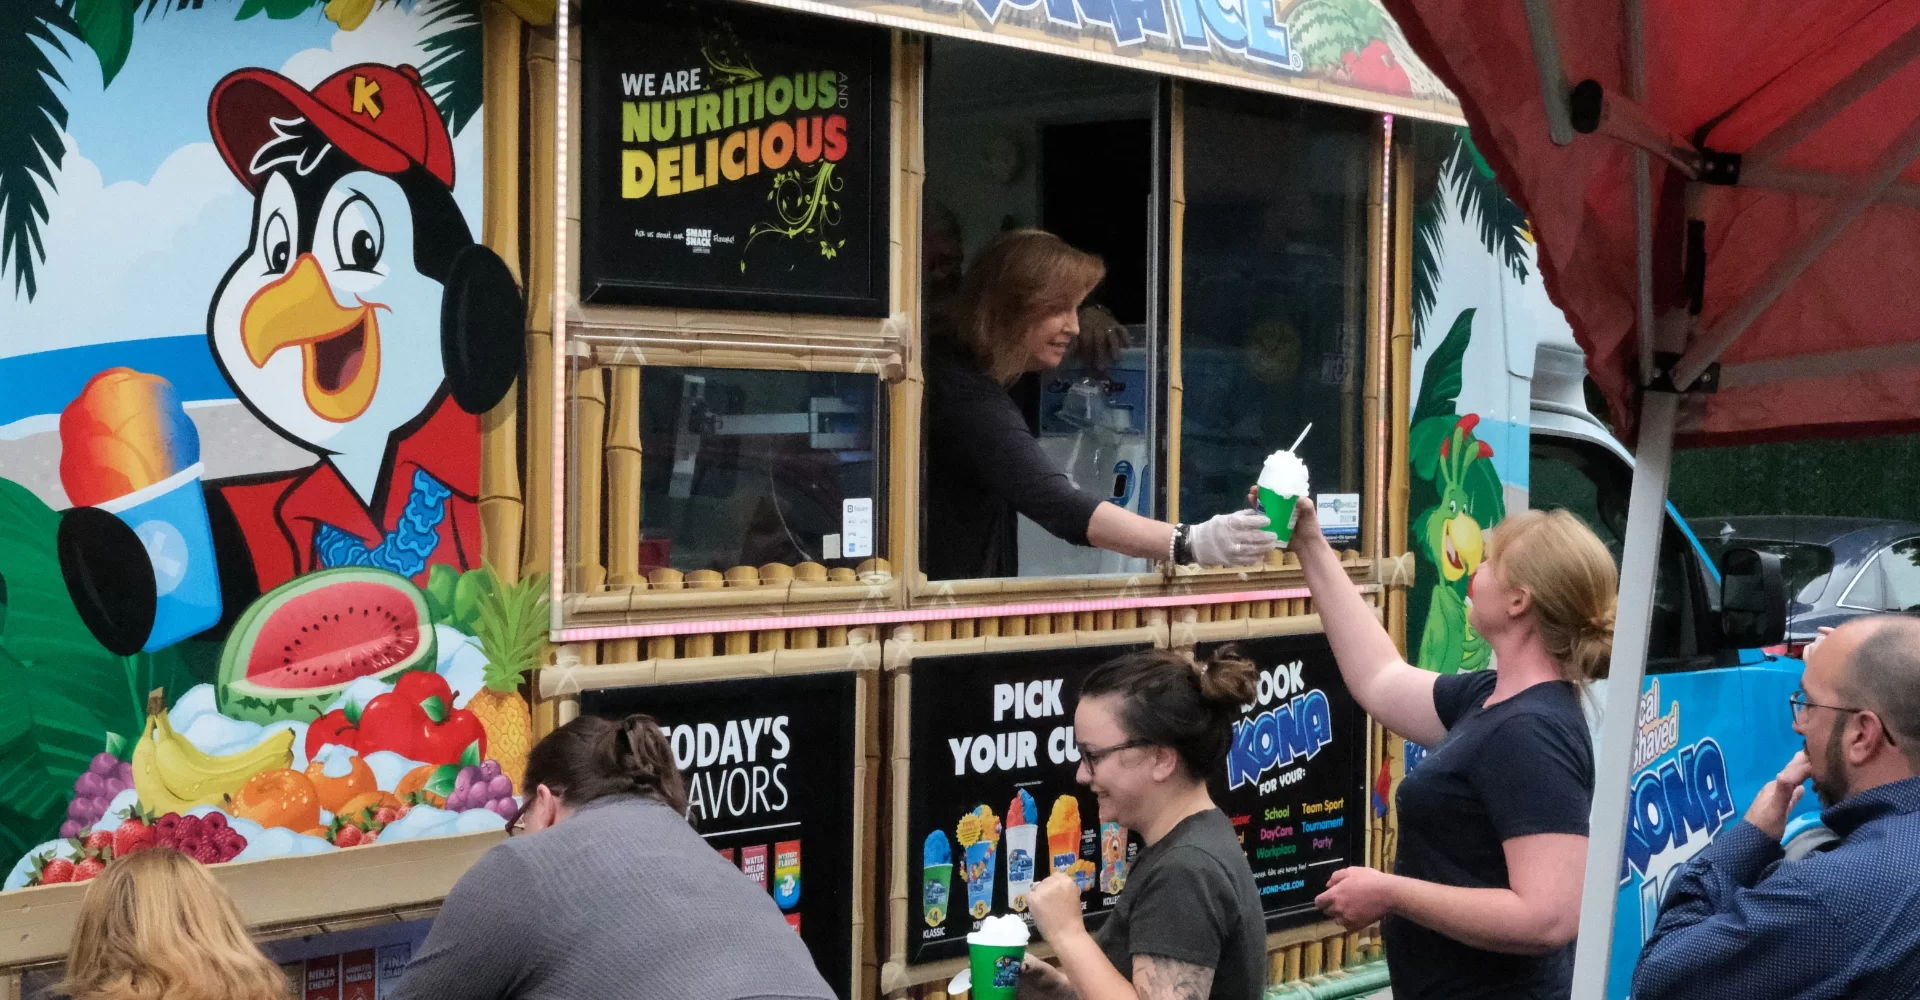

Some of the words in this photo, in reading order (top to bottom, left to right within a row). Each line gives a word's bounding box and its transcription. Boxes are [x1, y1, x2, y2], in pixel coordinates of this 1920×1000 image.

[621, 73, 656, 97] WE
[661, 68, 702, 95] ARE
[838, 71, 849, 109] AND
[352, 76, 381, 119] K
[621, 70, 838, 143] NUTRITIOUS
[621, 114, 848, 199] DELICIOUS
[686, 228, 712, 238] SMART
[686, 237, 711, 247] SNACK
[1241, 659, 1304, 713] OOK
[994, 678, 1064, 721] PICK
[1639, 680, 1659, 728] cal
[1226, 688, 1332, 791] KONA
[1633, 702, 1677, 769] haved
[948, 730, 1038, 776] YOUR
[1047, 726, 1081, 765] CU
[1259, 778, 1277, 796] FOR
[1279, 767, 1306, 787] YOUR:
[685, 763, 788, 822] AVORS
[1264, 805, 1289, 821] School
[1302, 802, 1322, 814] Team
[1324, 798, 1344, 813] Sport
[1302, 816, 1344, 833] Tournament
[1260, 826, 1293, 841] DayCare
[1256, 843, 1296, 859] Workplace
[1312, 837, 1333, 850] Party
[744, 855, 764, 865] WATER
[744, 863, 765, 874] MELON
[778, 858, 798, 868] FLAVOR
[1257, 879, 1305, 896] .KONA-ICE.COM
[922, 927, 945, 939] KLASSIC
[308, 967, 335, 980] NINJA
[345, 971, 372, 983] MANGO
[308, 979, 335, 991] CHERRY
